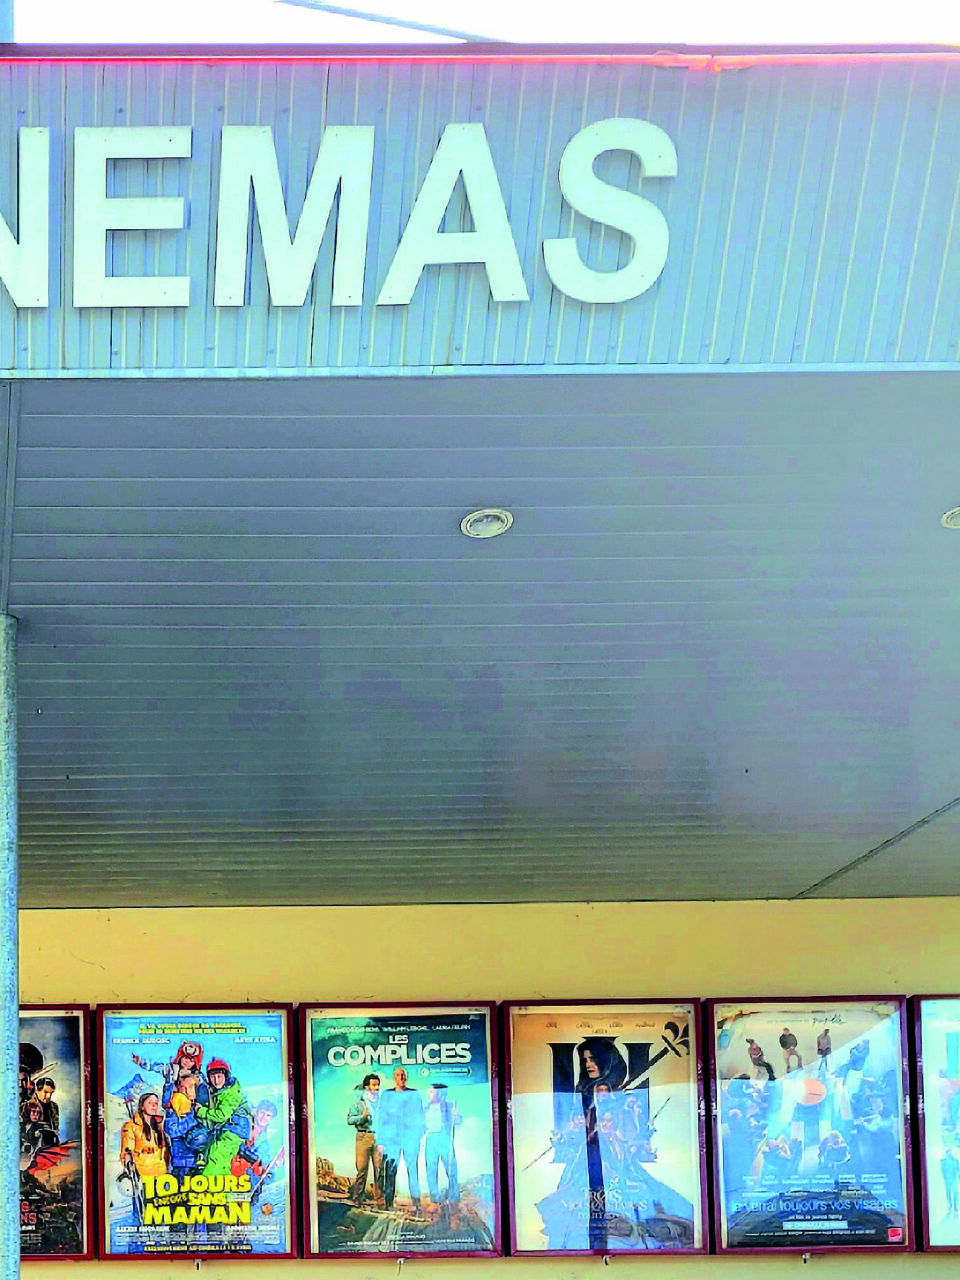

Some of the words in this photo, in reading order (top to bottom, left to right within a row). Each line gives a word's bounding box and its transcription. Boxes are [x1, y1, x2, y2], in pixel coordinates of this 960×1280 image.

[388, 1034, 409, 1044] LES
[327, 1042, 472, 1067] COMPLICES
[142, 1174, 179, 1199] 10
[179, 1174, 252, 1193] JOURS
[188, 1192, 228, 1206] SANS
[143, 1202, 252, 1226] MAMAN
